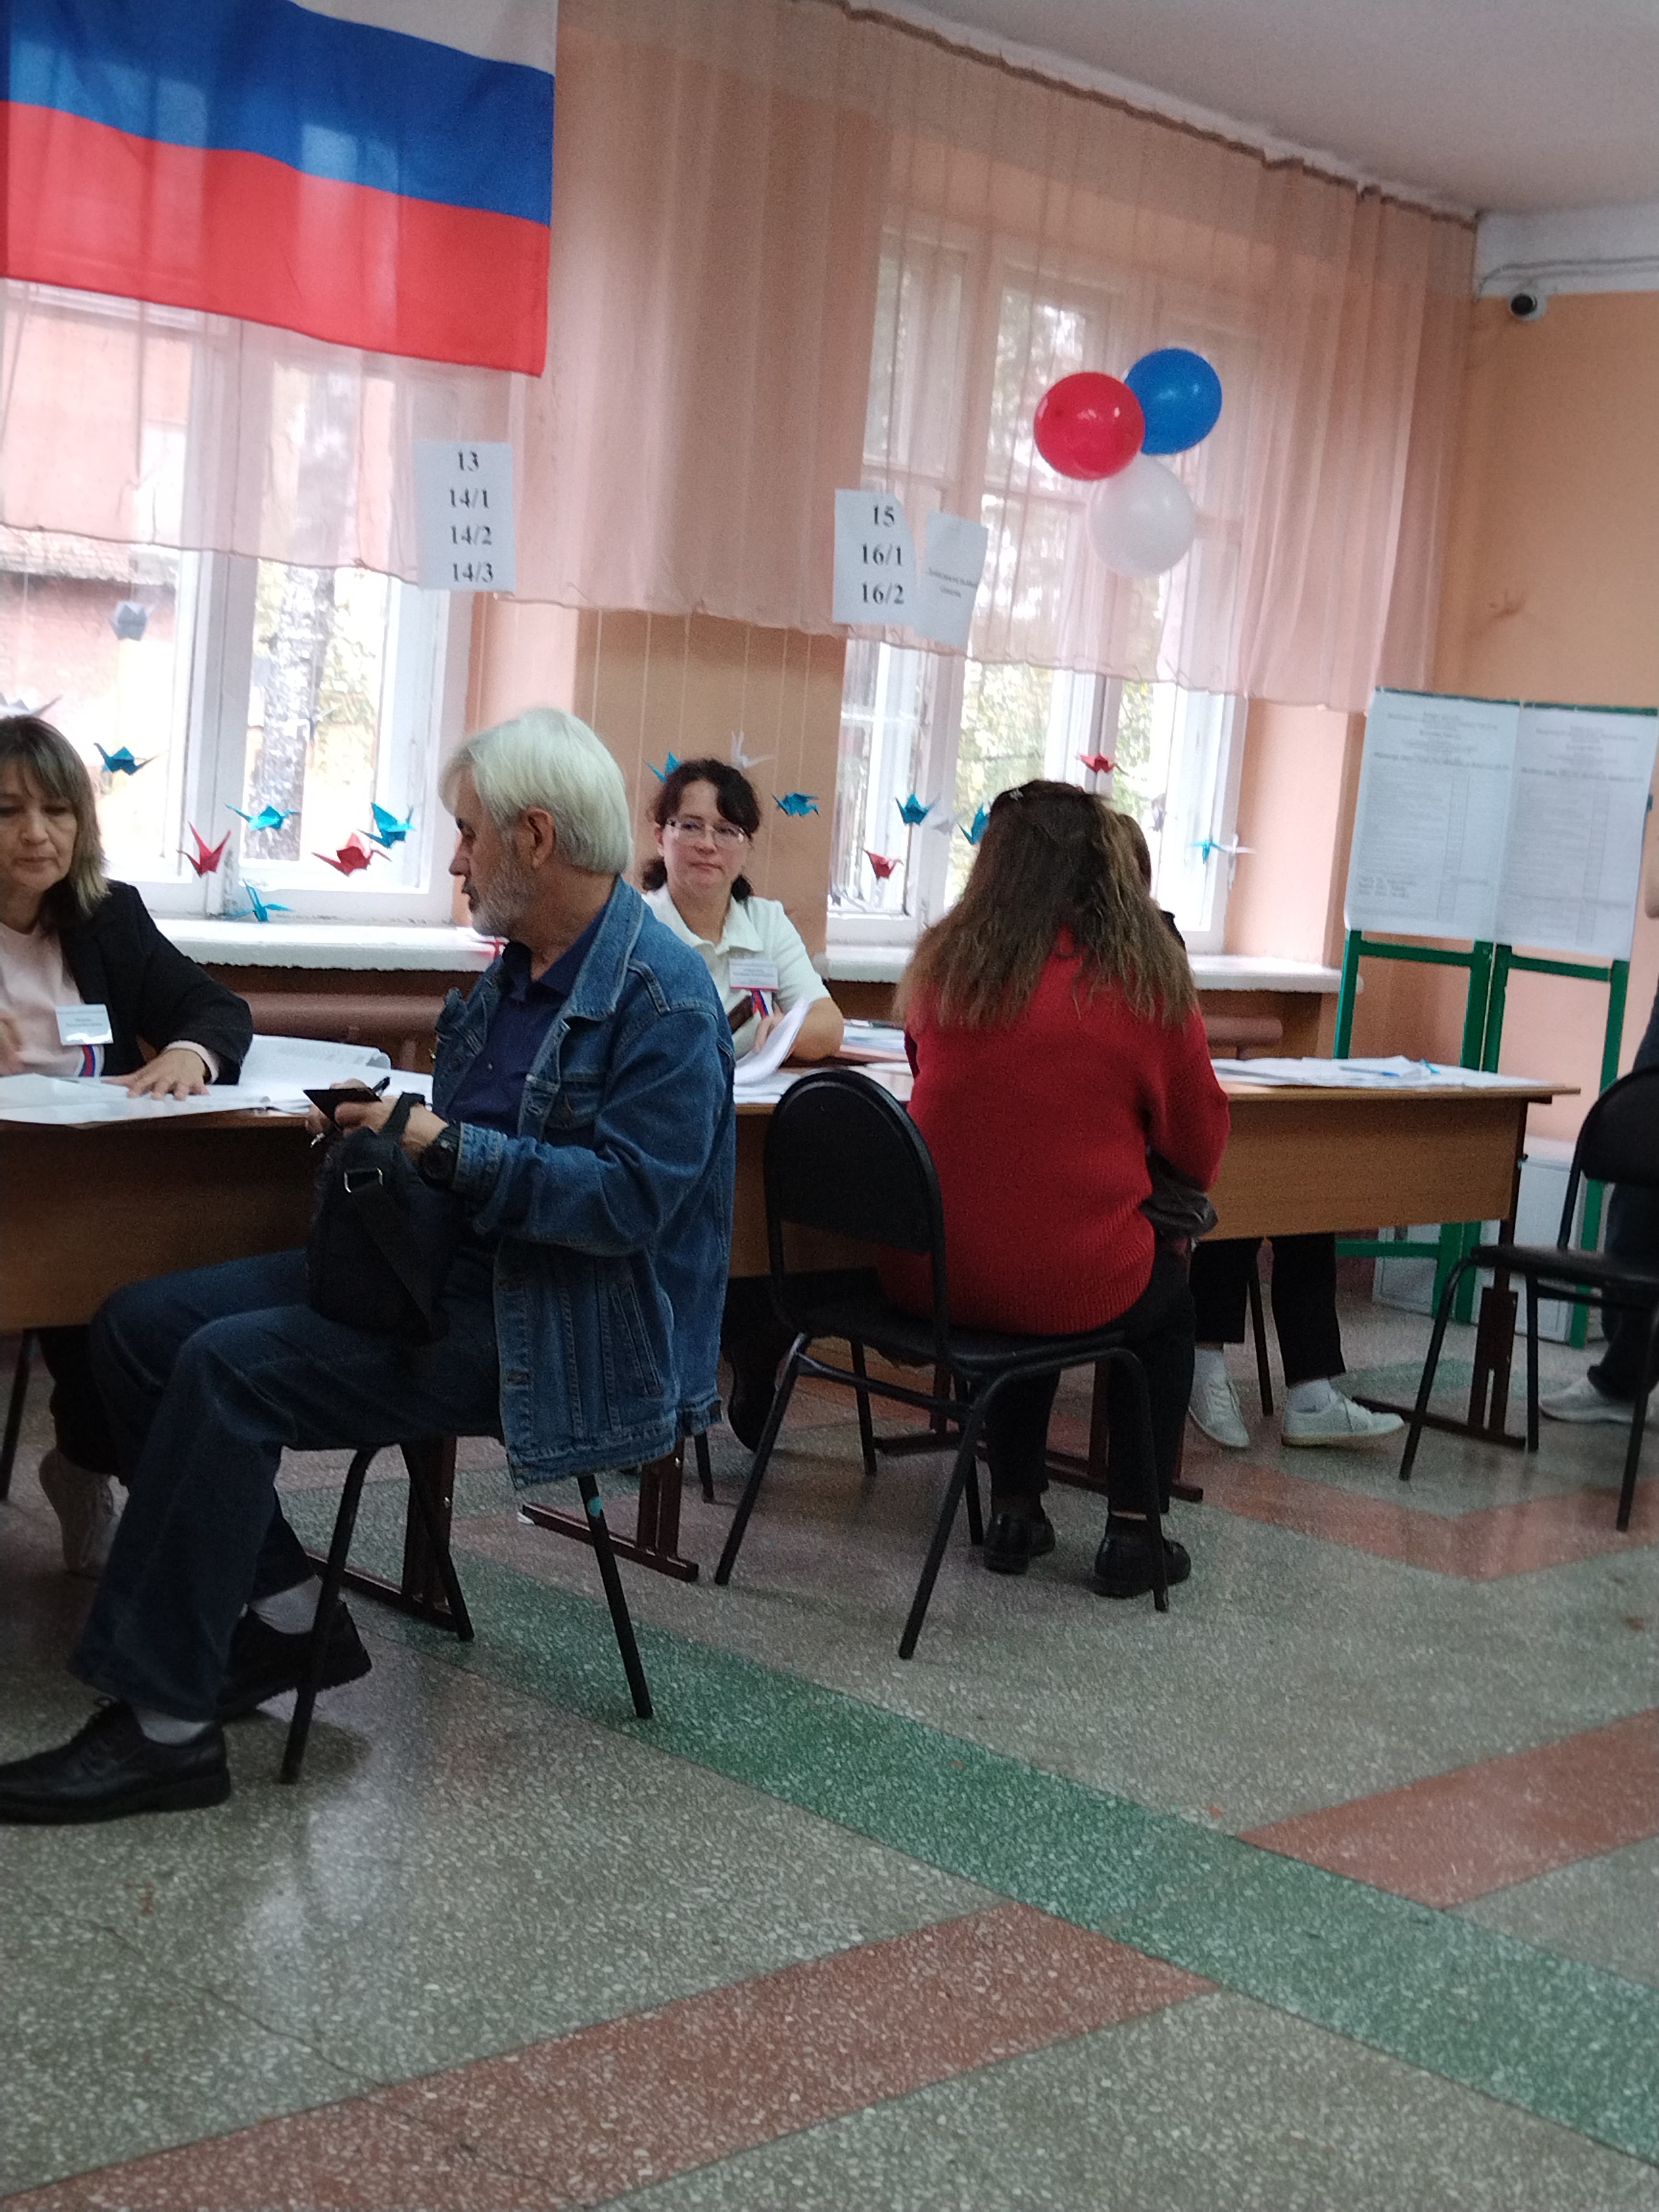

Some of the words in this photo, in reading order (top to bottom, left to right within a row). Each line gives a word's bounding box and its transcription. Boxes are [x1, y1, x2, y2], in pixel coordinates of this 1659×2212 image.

[457, 449, 479, 471] 13
[450, 488, 490, 509] 14/1
[872, 504, 895, 528] 15
[450, 524, 492, 545] 14/2
[861, 542, 903, 566] 16/1
[453, 561, 493, 583] 14/3
[862, 581, 904, 605] 16/2
